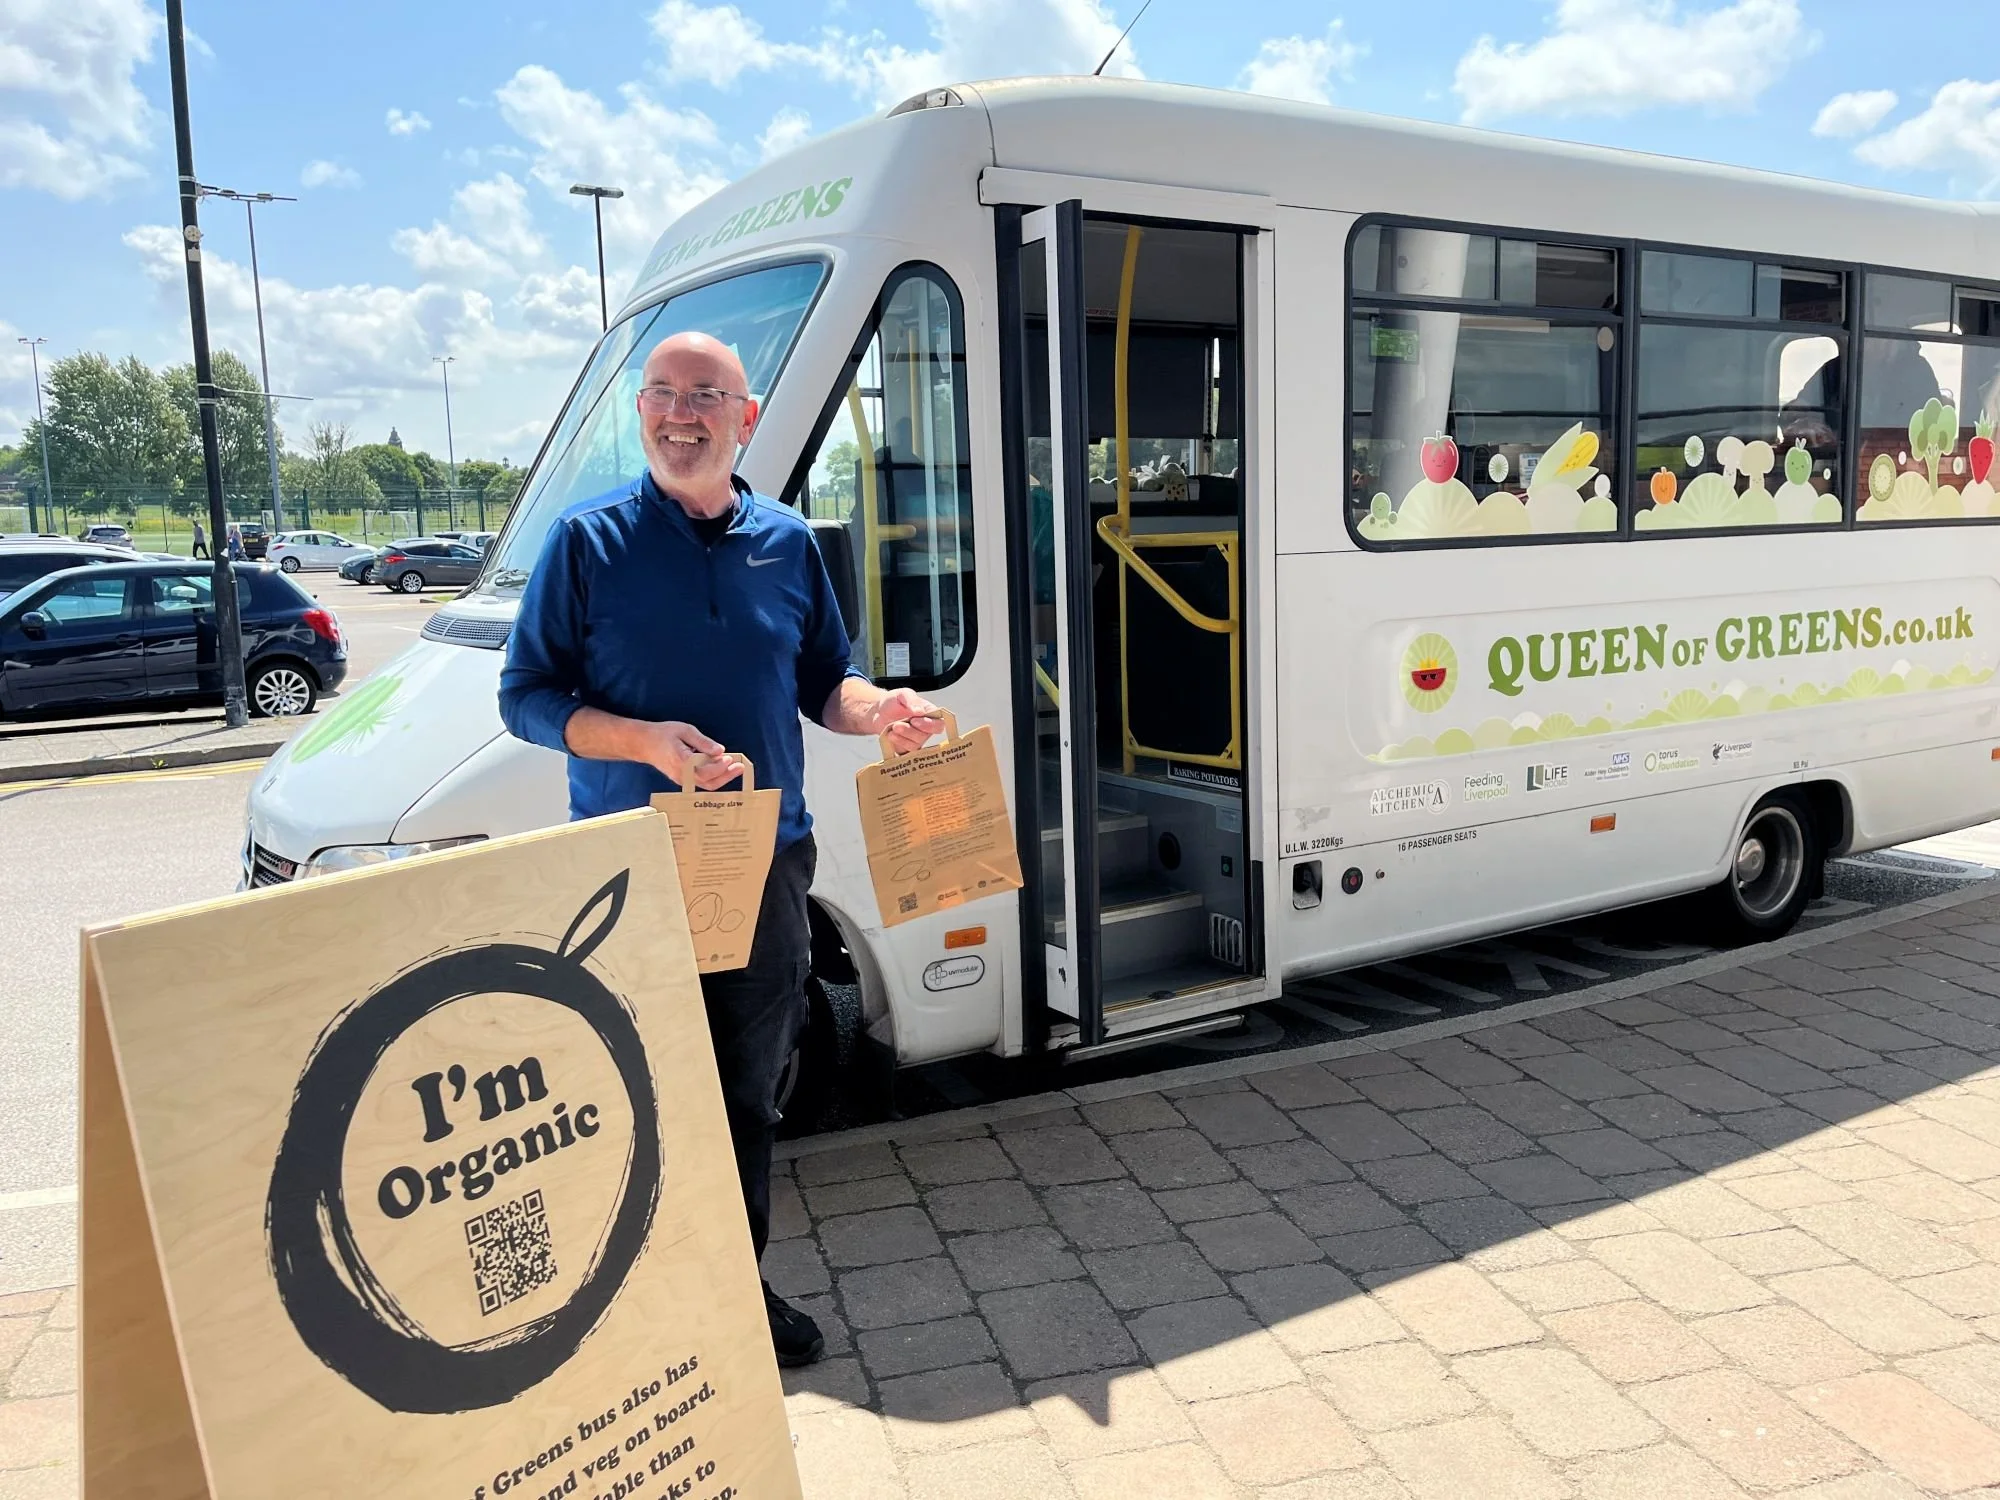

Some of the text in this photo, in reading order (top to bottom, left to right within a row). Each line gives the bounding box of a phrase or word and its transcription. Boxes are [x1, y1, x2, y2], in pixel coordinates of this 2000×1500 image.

[709, 177, 853, 248] GREENS
[1487, 606, 1974, 697] QUEEN OF GREENS.co.uk
[1659, 750, 1678, 760] torus
[1724, 742, 1752, 752] Liverpool
[880, 759, 911, 775] Roasted
[913, 753, 939, 764] Sweet
[941, 741, 973, 757] Potatoes
[891, 768, 910, 778] with
[919, 760, 943, 770] Greek
[946, 752, 966, 763] twist
[1613, 753, 1629, 764] NHS
[1174, 767, 1239, 787] BAKING POTATOES
[1465, 772, 1502, 789] Feeding
[1545, 766, 1568, 780] LIFE
[1372, 784, 1434, 803] ALCHEMIC
[1465, 784, 1509, 801] Liverpool
[694, 801, 725, 809] Cabbage
[1372, 797, 1424, 815] KITCHEN
[1285, 842, 1309, 854] U.L.W.
[1398, 830, 1477, 852] 16 PASSENGER SEATS
[412, 1057, 549, 1143] I'm
[378, 1102, 600, 1220] Organic
[493, 1435, 573, 1496] Greens
[578, 1407, 617, 1442] bus
[622, 1379, 661, 1416] also
[665, 1355, 699, 1387] has
[582, 1446, 621, 1479] veg
[625, 1426, 650, 1452] on
[654, 1381, 717, 1432] board.
[649, 1435, 697, 1476] than
[695, 1460, 716, 1482] to
